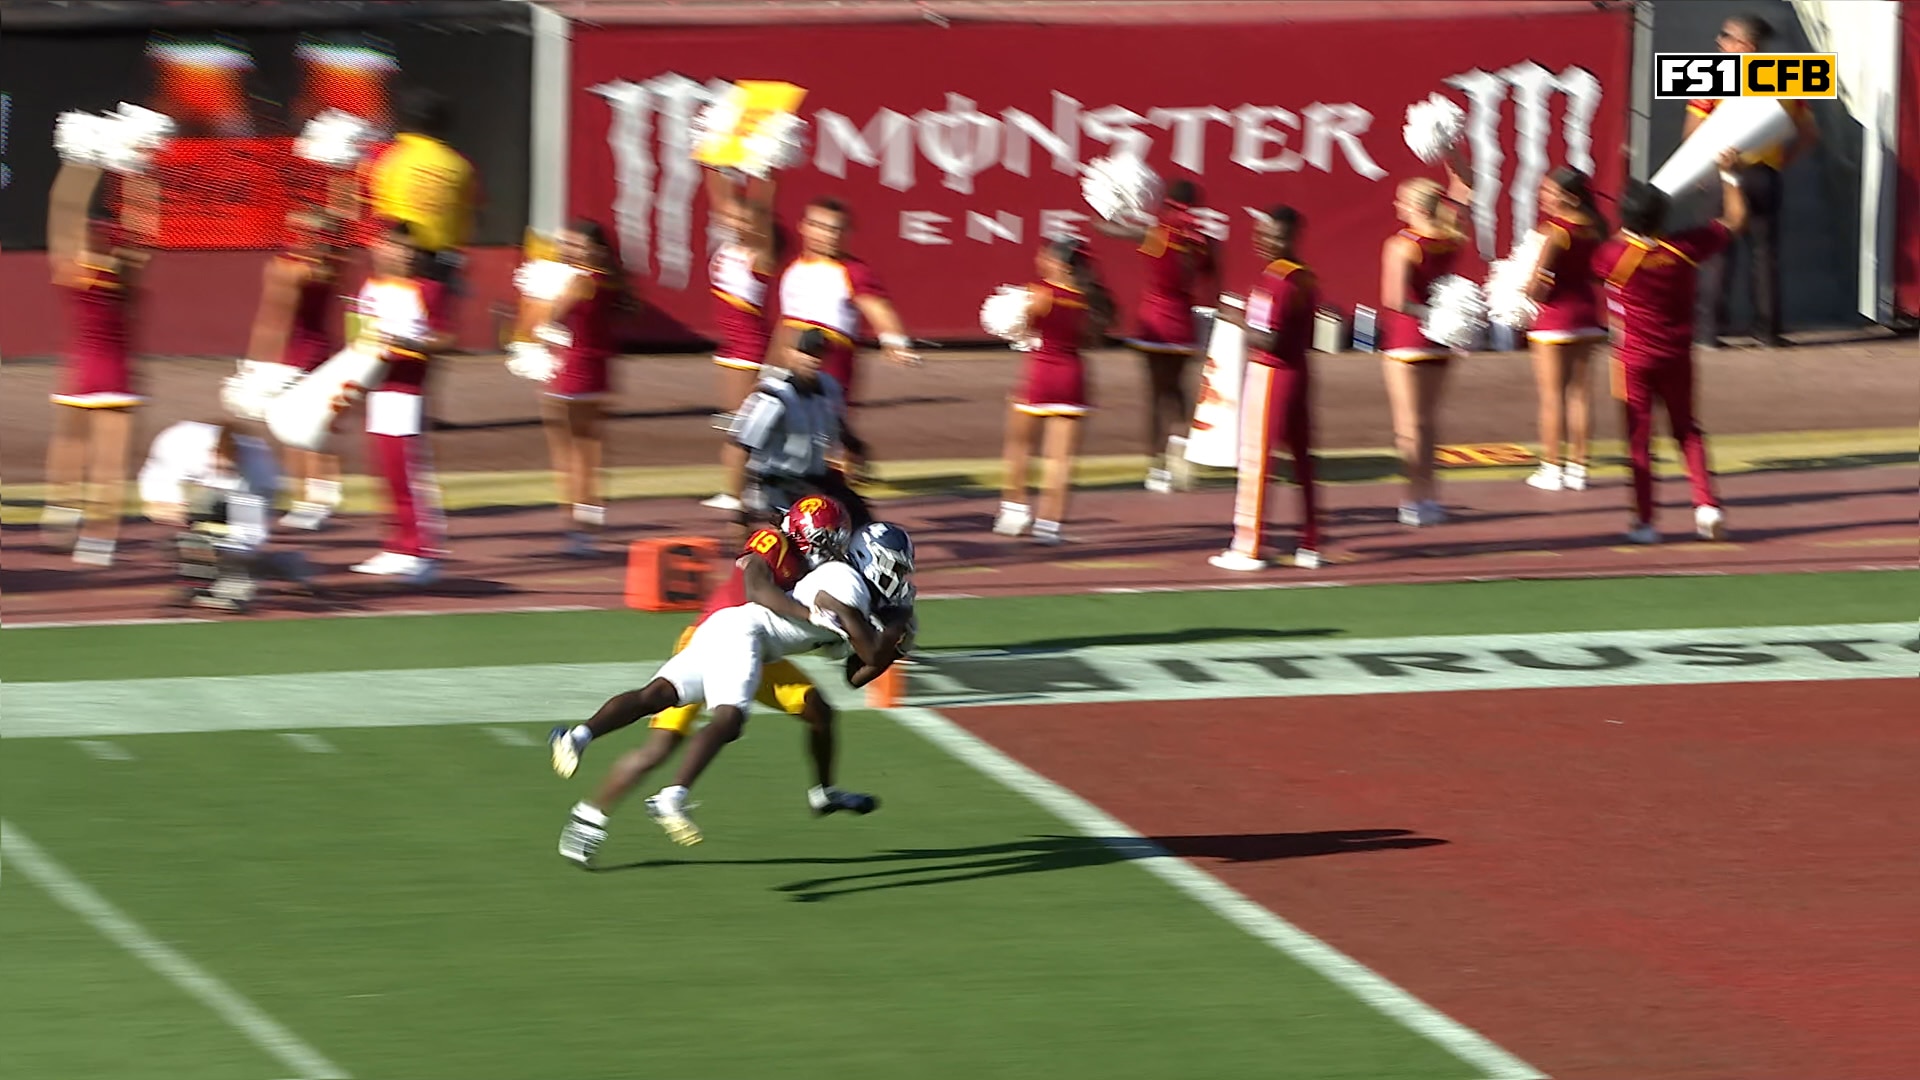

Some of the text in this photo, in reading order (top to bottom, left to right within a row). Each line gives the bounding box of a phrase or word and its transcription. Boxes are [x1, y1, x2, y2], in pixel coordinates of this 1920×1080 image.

[813, 89, 1389, 194] MONSTER
[899, 208, 1274, 245] ENEG
[749, 530, 778, 554] 19
[1152, 638, 1919, 683] ITRUST
